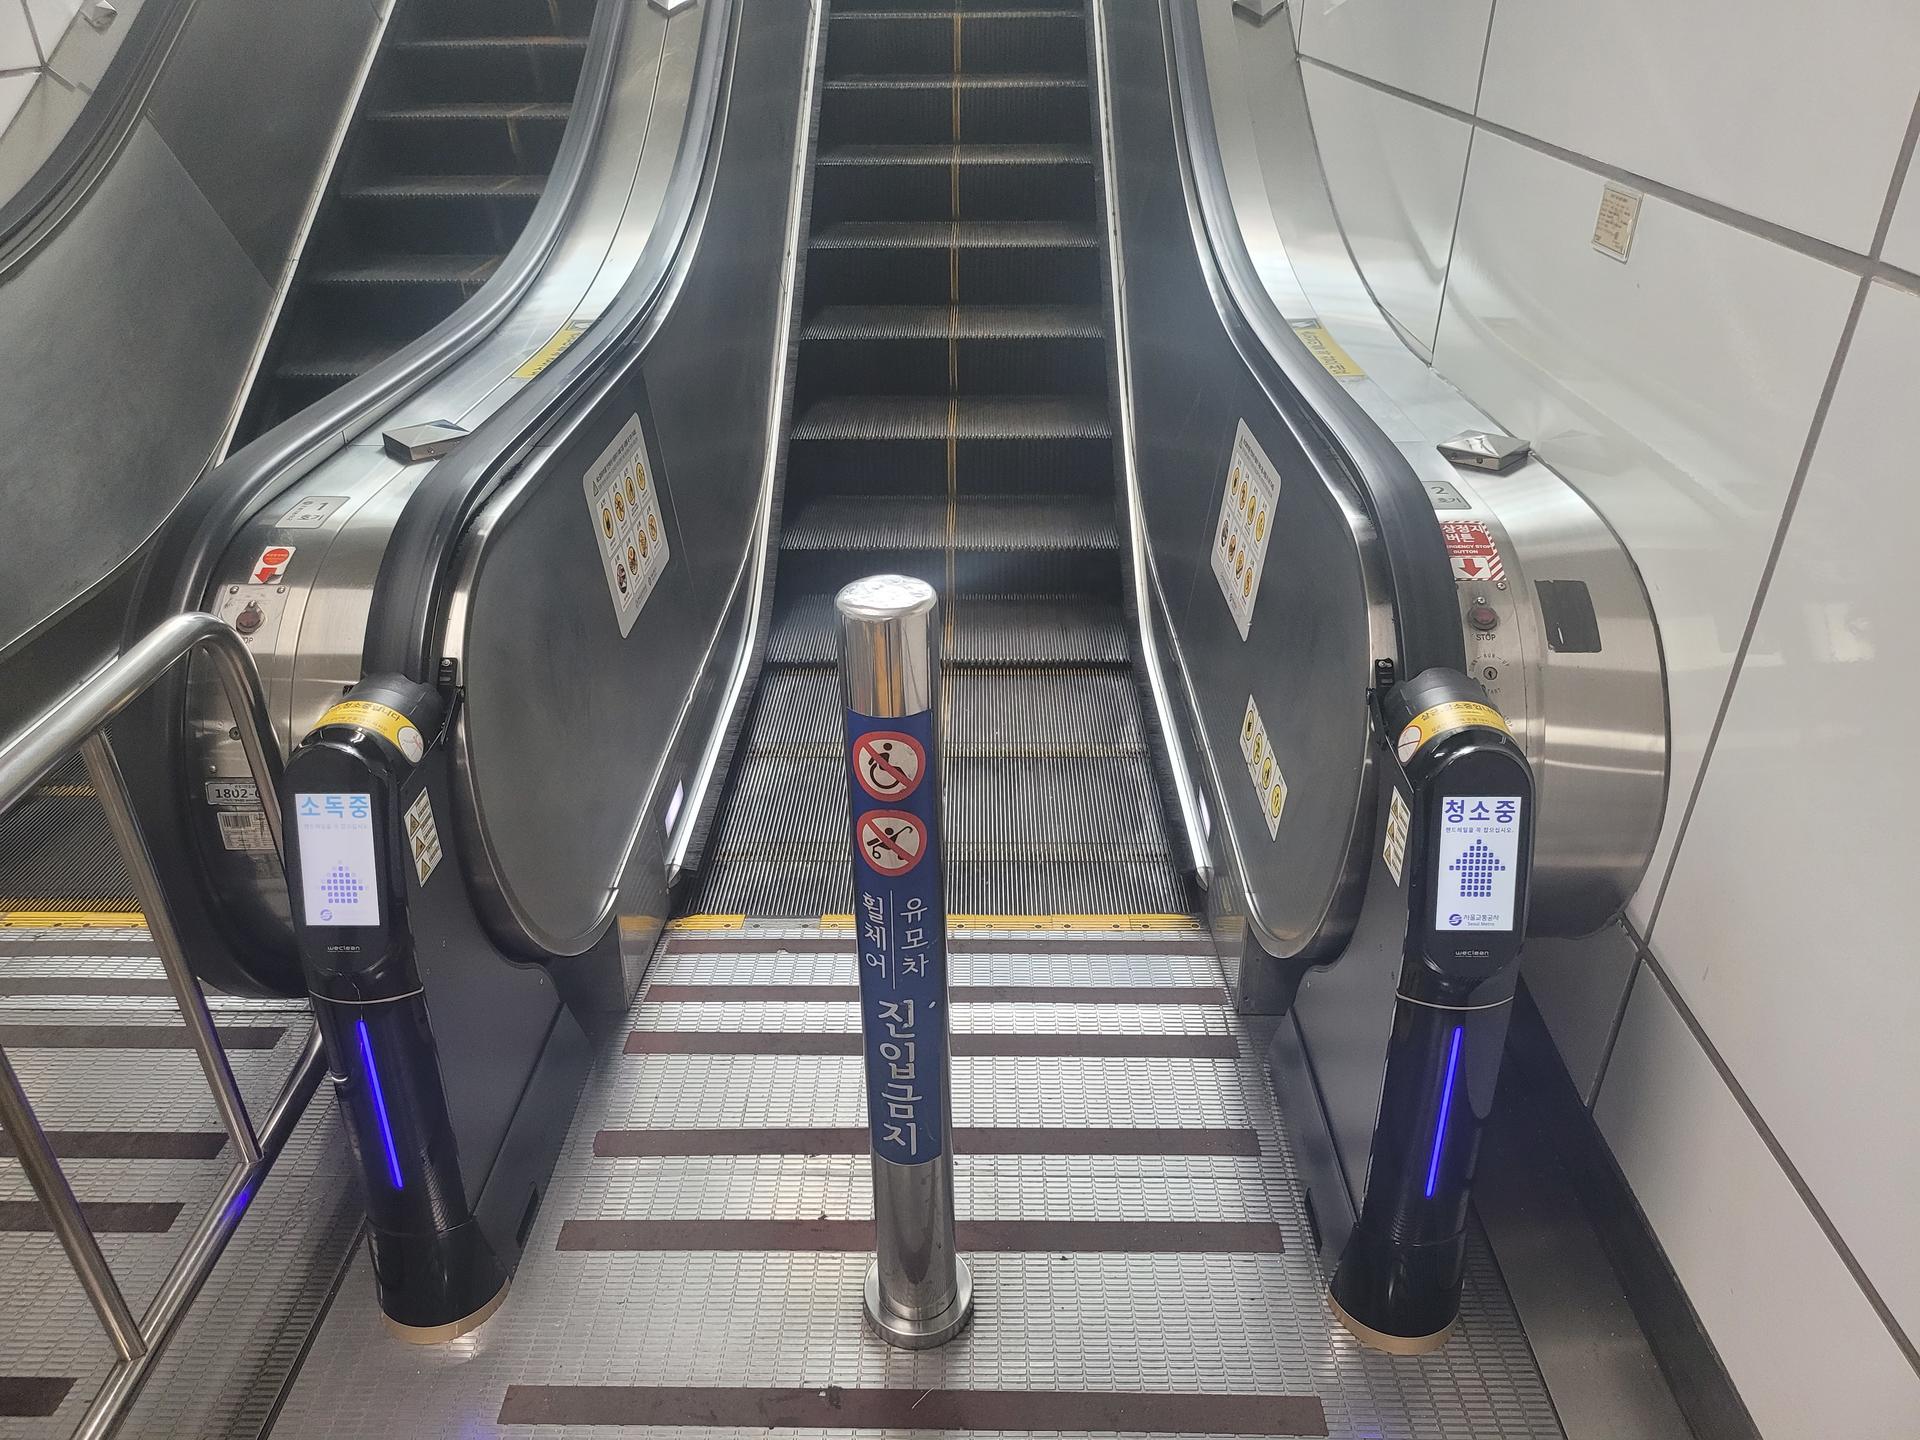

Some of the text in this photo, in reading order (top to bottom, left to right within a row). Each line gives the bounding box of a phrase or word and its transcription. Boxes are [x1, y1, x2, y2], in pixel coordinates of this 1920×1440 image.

[1430, 486, 1449, 495] 2
[1442, 524, 1484, 534] 상정지
[1445, 533, 1475, 543] 버튼
[1475, 633, 1496, 641] STOP
[300, 795, 369, 819] 소독중
[1444, 799, 1516, 824] 청소중
[861, 891, 887, 979] 휠체어
[900, 897, 930, 978] 유모차
[878, 999, 924, 1157] 진입금지
